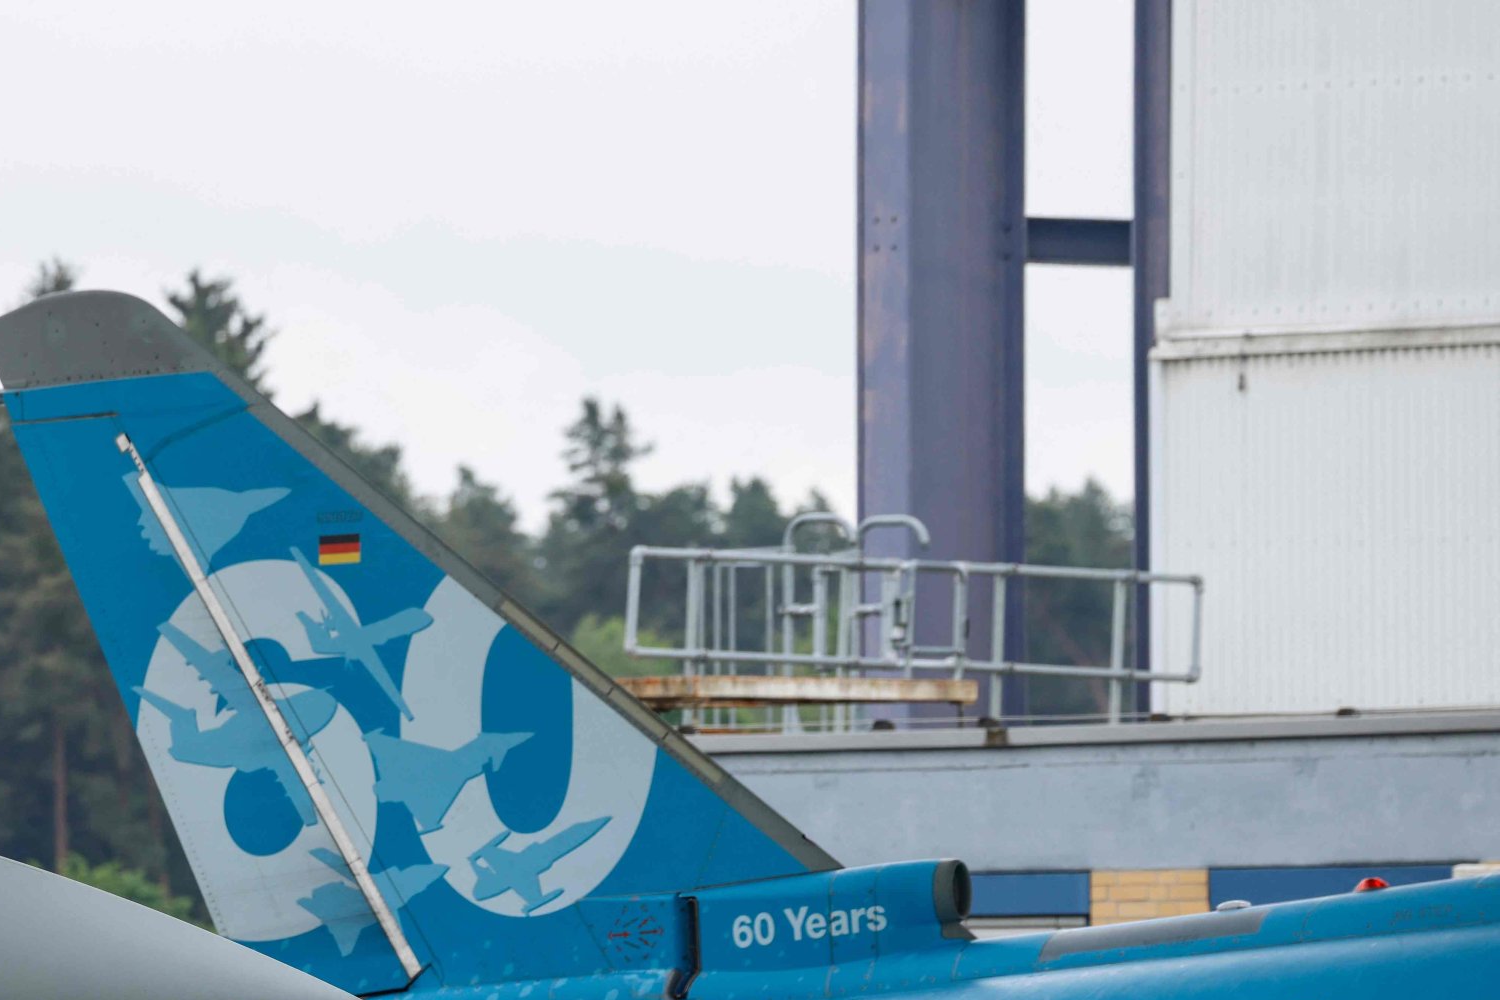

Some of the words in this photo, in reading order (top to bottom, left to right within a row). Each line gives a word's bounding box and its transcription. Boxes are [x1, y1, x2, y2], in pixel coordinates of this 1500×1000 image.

[136, 559, 657, 942] 60
[732, 914, 775, 949] 60
[783, 905, 887, 942] Years
